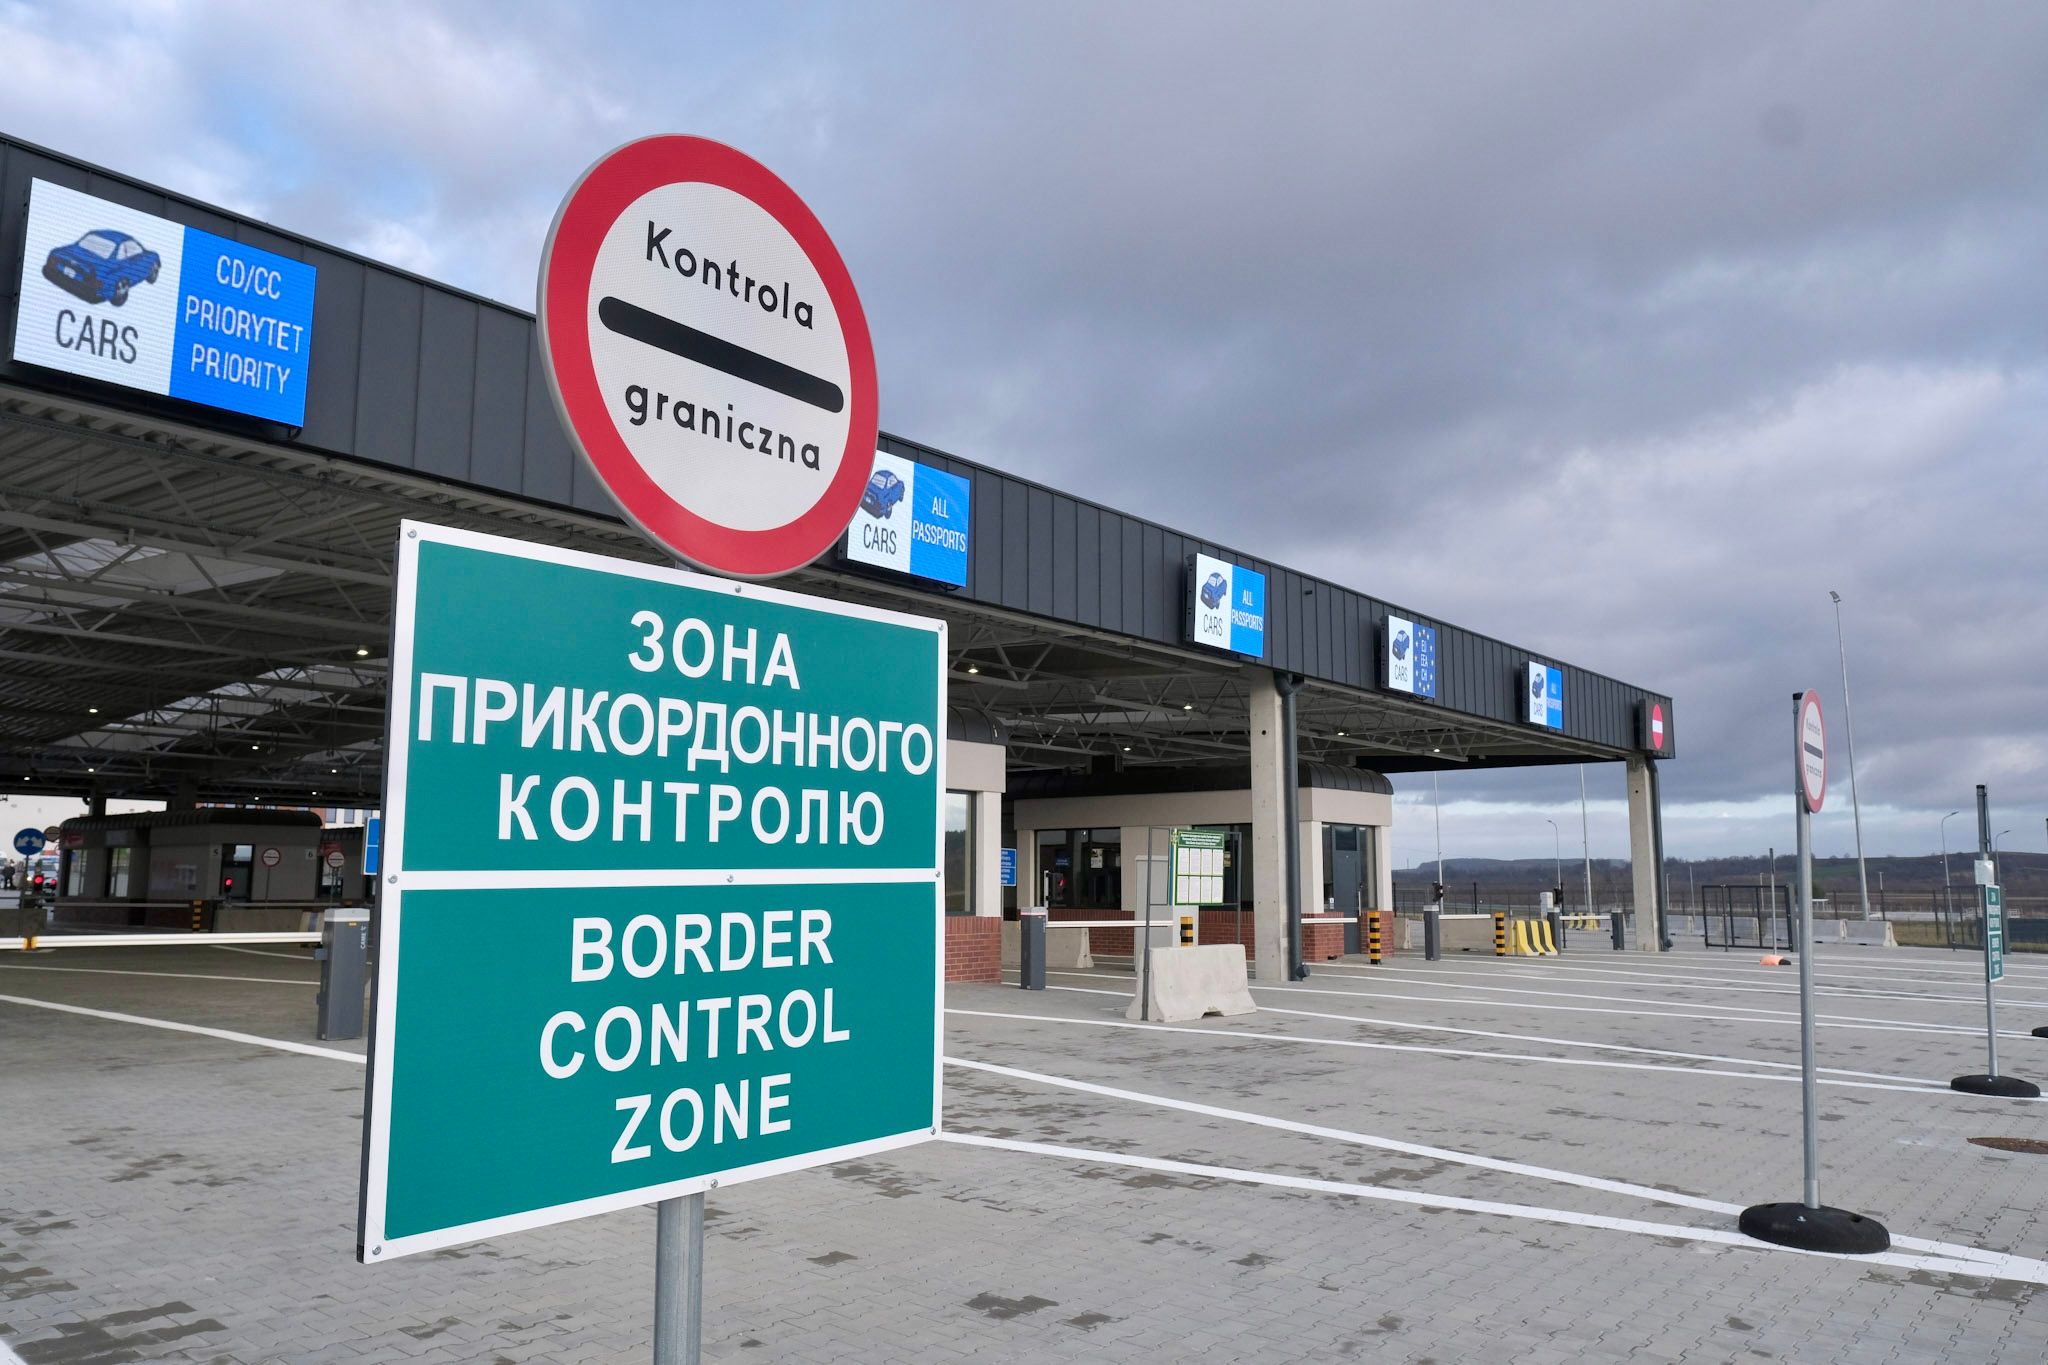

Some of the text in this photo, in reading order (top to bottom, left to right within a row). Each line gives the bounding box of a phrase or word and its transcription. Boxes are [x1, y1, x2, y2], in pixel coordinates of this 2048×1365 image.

[216, 255, 282, 299] CD/CC
[646, 220, 813, 330] Kontrola
[56, 309, 139, 364] CARS
[186, 295, 304, 353] PRIORYTET
[191, 343, 291, 394] PRIORITY
[625, 384, 821, 471] graniczna
[932, 496, 949, 519] ALL
[863, 523, 897, 555] CARS
[913, 520, 966, 552] PASSPORTS
[1203, 614, 1223, 636] CARS
[1231, 609, 1263, 631] PASSPORTS
[1242, 589, 1253, 606] ALL
[628, 610, 800, 690] ЗОНА
[418, 672, 933, 776] ПРИКОРДОННОГО
[498, 773, 884, 846] КОНТРОЛЮ
[571, 909, 834, 983] BORDER
[539, 987, 850, 1079] CONTROL
[611, 1073, 791, 1164] ZONE
